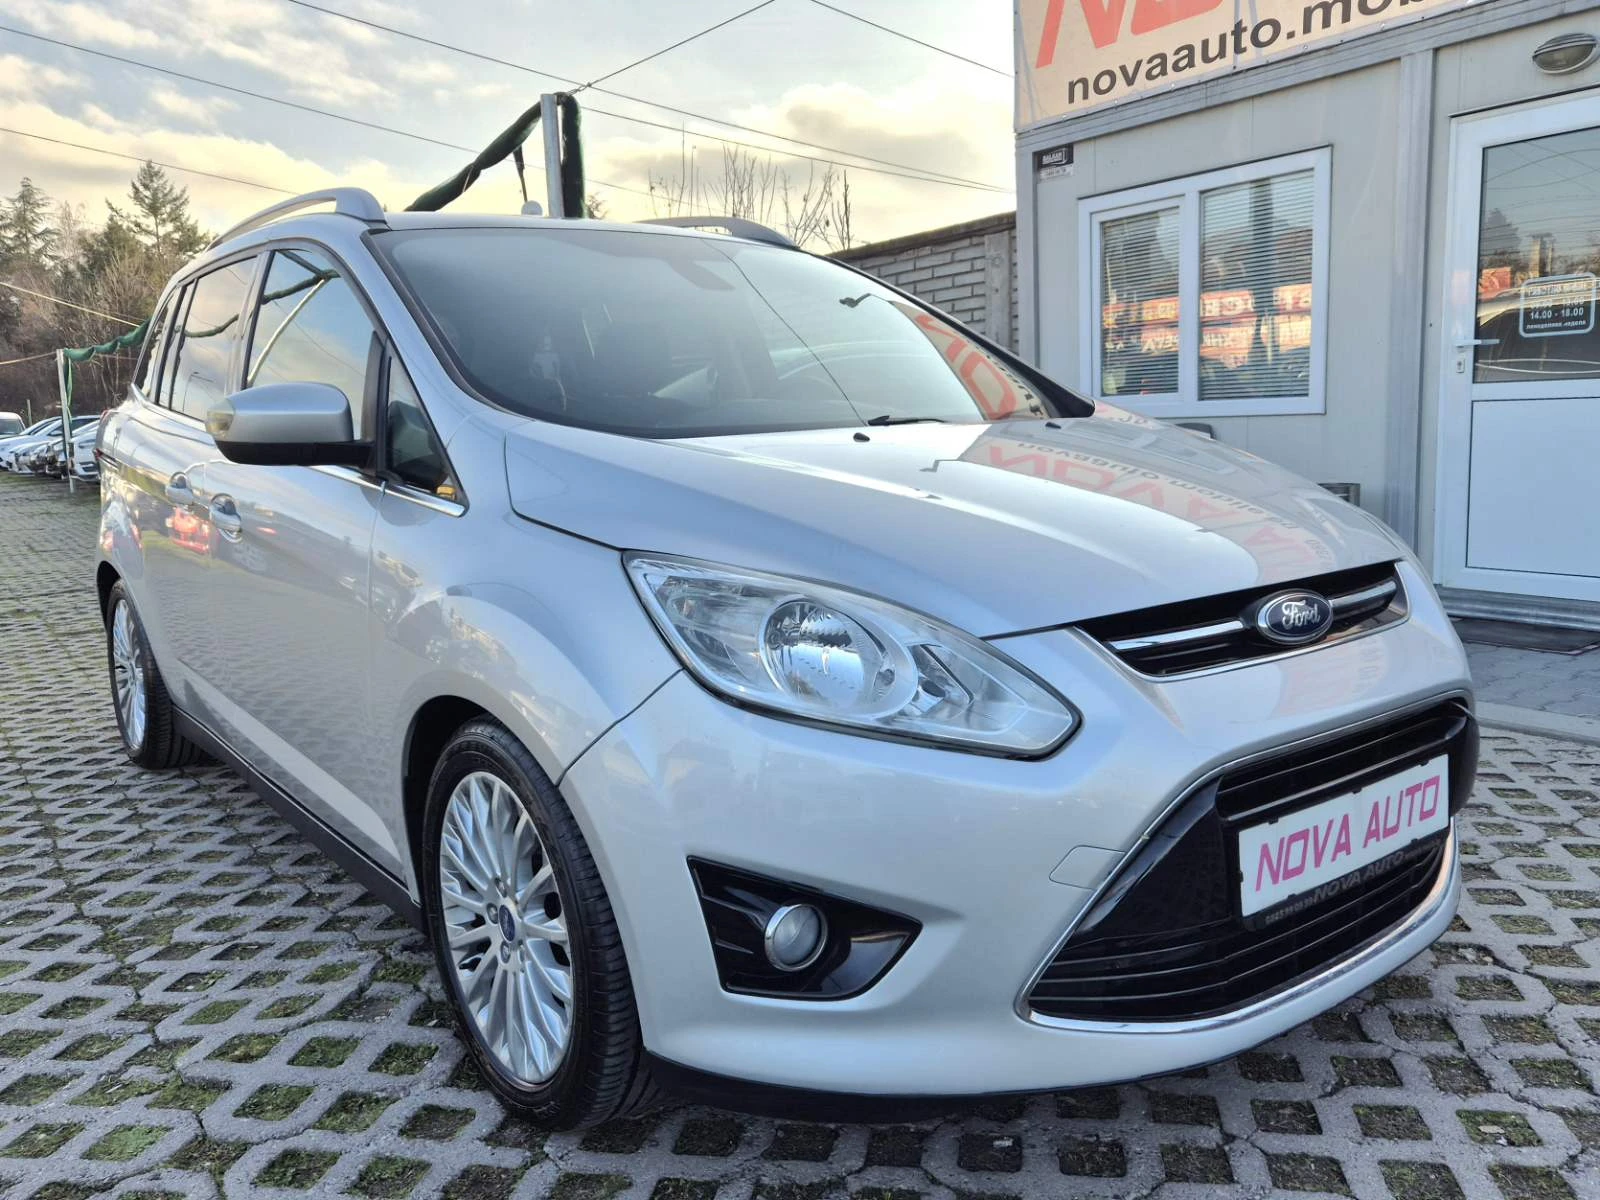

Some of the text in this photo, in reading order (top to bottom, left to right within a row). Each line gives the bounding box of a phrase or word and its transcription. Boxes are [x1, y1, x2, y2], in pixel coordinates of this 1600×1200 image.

[1067, 0, 1423, 104] novaauto.mo
[1530, 310, 1552, 320] 14.00
[1561, 307, 1584, 317] 18.00
[1282, 600, 1321, 630] Ford
[1255, 775, 1441, 892] NOVA AUTO
[1313, 871, 1362, 902] NOVA
[1363, 851, 1405, 881] AUTO
